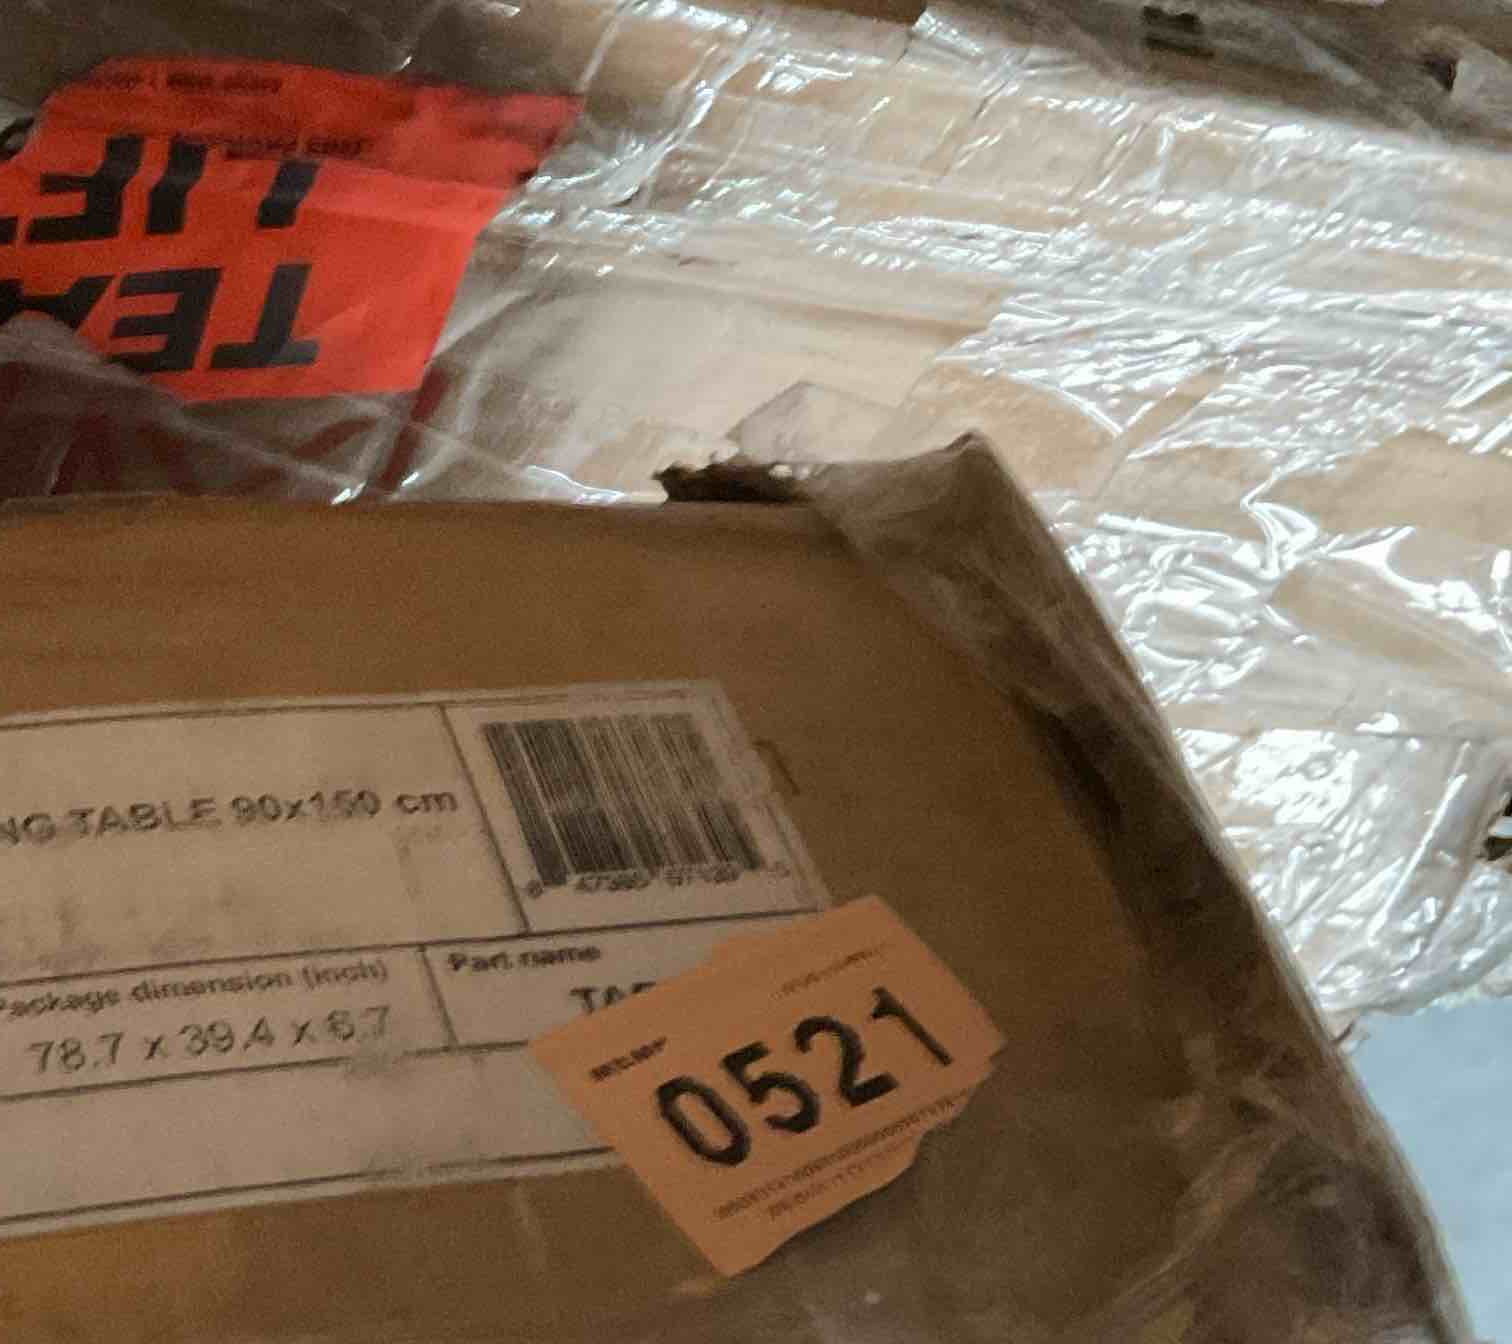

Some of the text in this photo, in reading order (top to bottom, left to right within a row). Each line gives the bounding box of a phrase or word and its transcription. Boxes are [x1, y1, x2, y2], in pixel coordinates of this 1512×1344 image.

[67, 796, 223, 839] TABLE
[229, 787, 383, 824] 90x150
[395, 789, 458, 814] cm
[129, 968, 292, 1004] dimension
[301, 958, 387, 991] (inch)
[518, 944, 602, 968] name
[26, 1031, 125, 1075] 78.7
[143, 1034, 169, 1061] x
[179, 1016, 276, 1056] 39.4
[290, 1019, 315, 1046] x
[654, 986, 954, 1167] 0521
